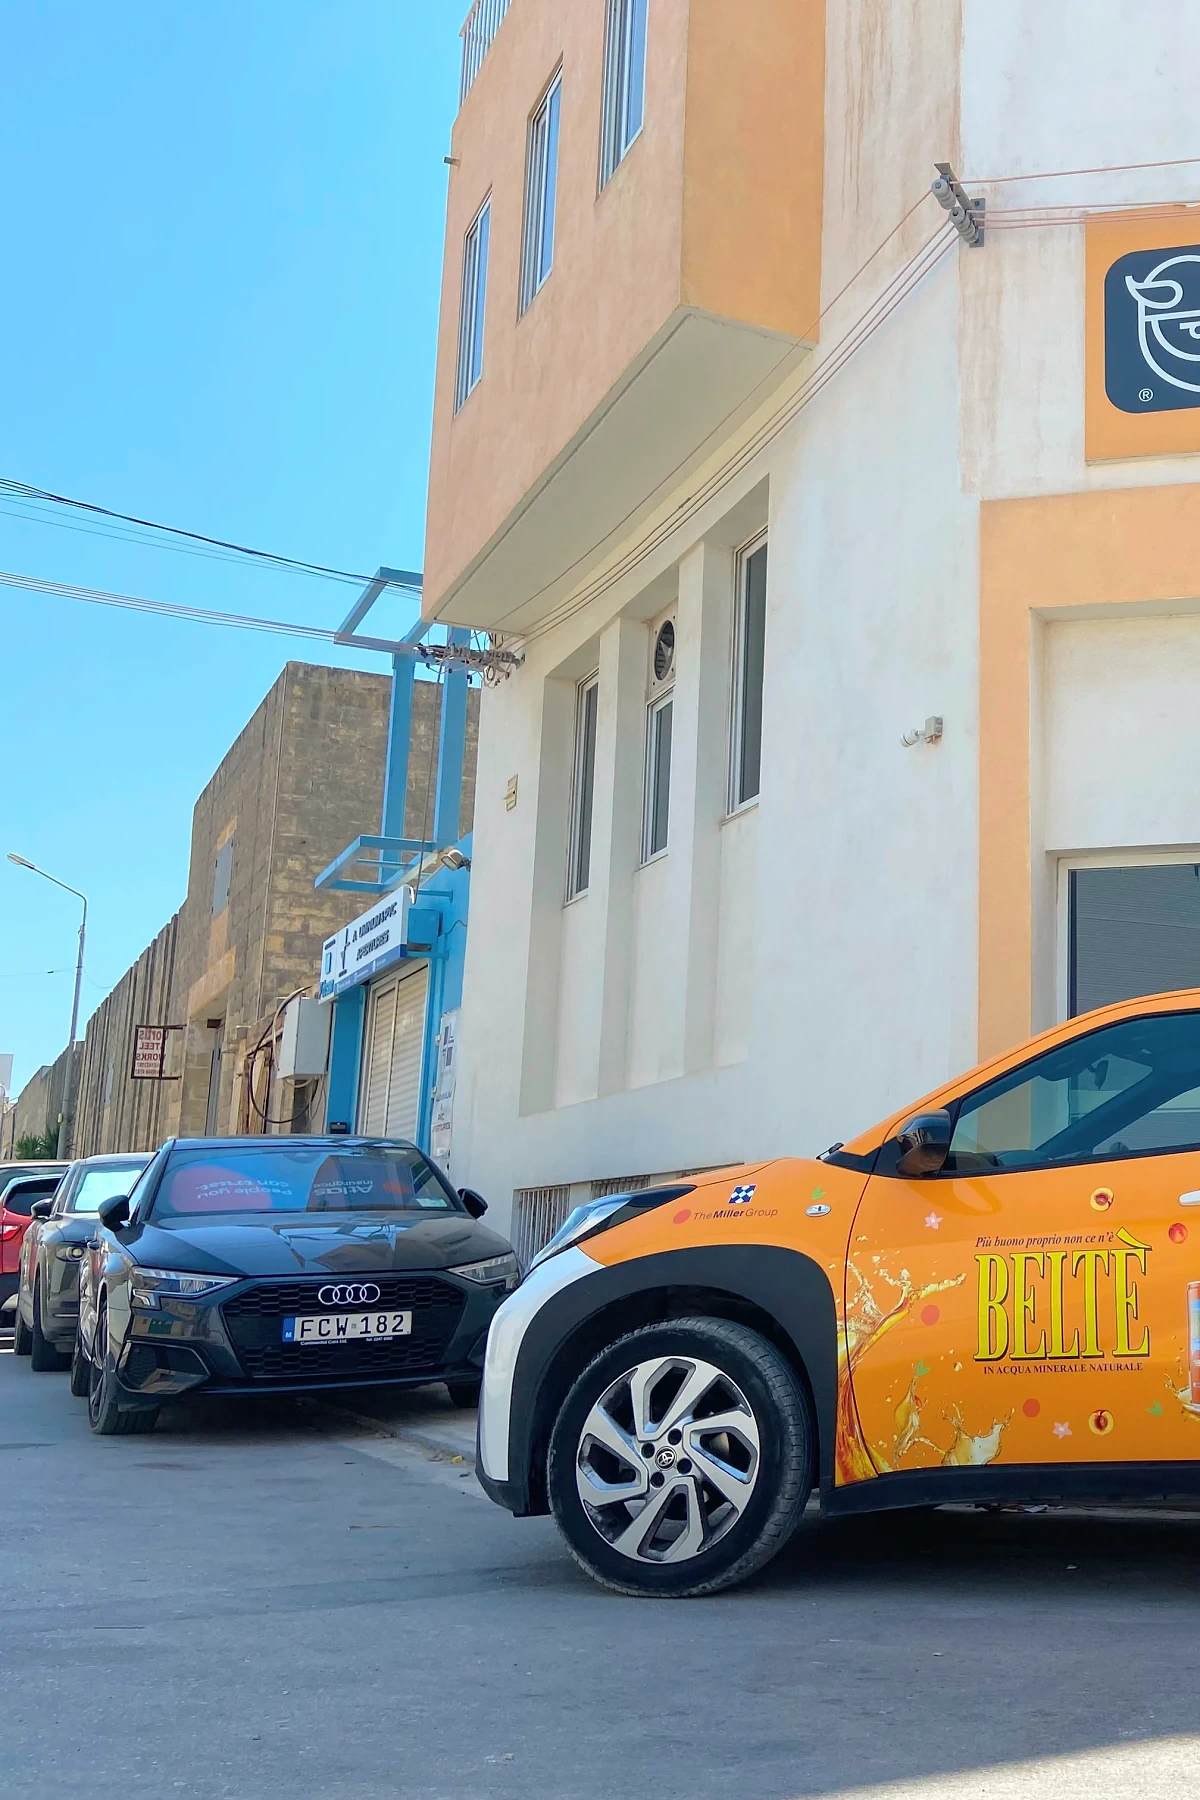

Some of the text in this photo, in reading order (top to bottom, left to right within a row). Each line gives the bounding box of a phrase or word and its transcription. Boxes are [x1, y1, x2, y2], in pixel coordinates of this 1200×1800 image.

[256, 1179, 289, 1188] can
[313, 1179, 374, 1188] insurance
[313, 1184, 374, 1196] Atlas
[197, 1187, 232, 1199] you
[975, 1236, 993, 1248] Più
[994, 1235, 1024, 1247] buono
[1025, 1234, 1062, 1249] proprio
[1064, 1235, 1082, 1244] non
[1085, 1235, 1096, 1243] ce
[973, 1226, 1152, 1361] BELTÈ
[300, 1314, 404, 1339] FCW 182
[984, 1362, 1143, 1376] IN ACQUA MINERALE NATURALE
